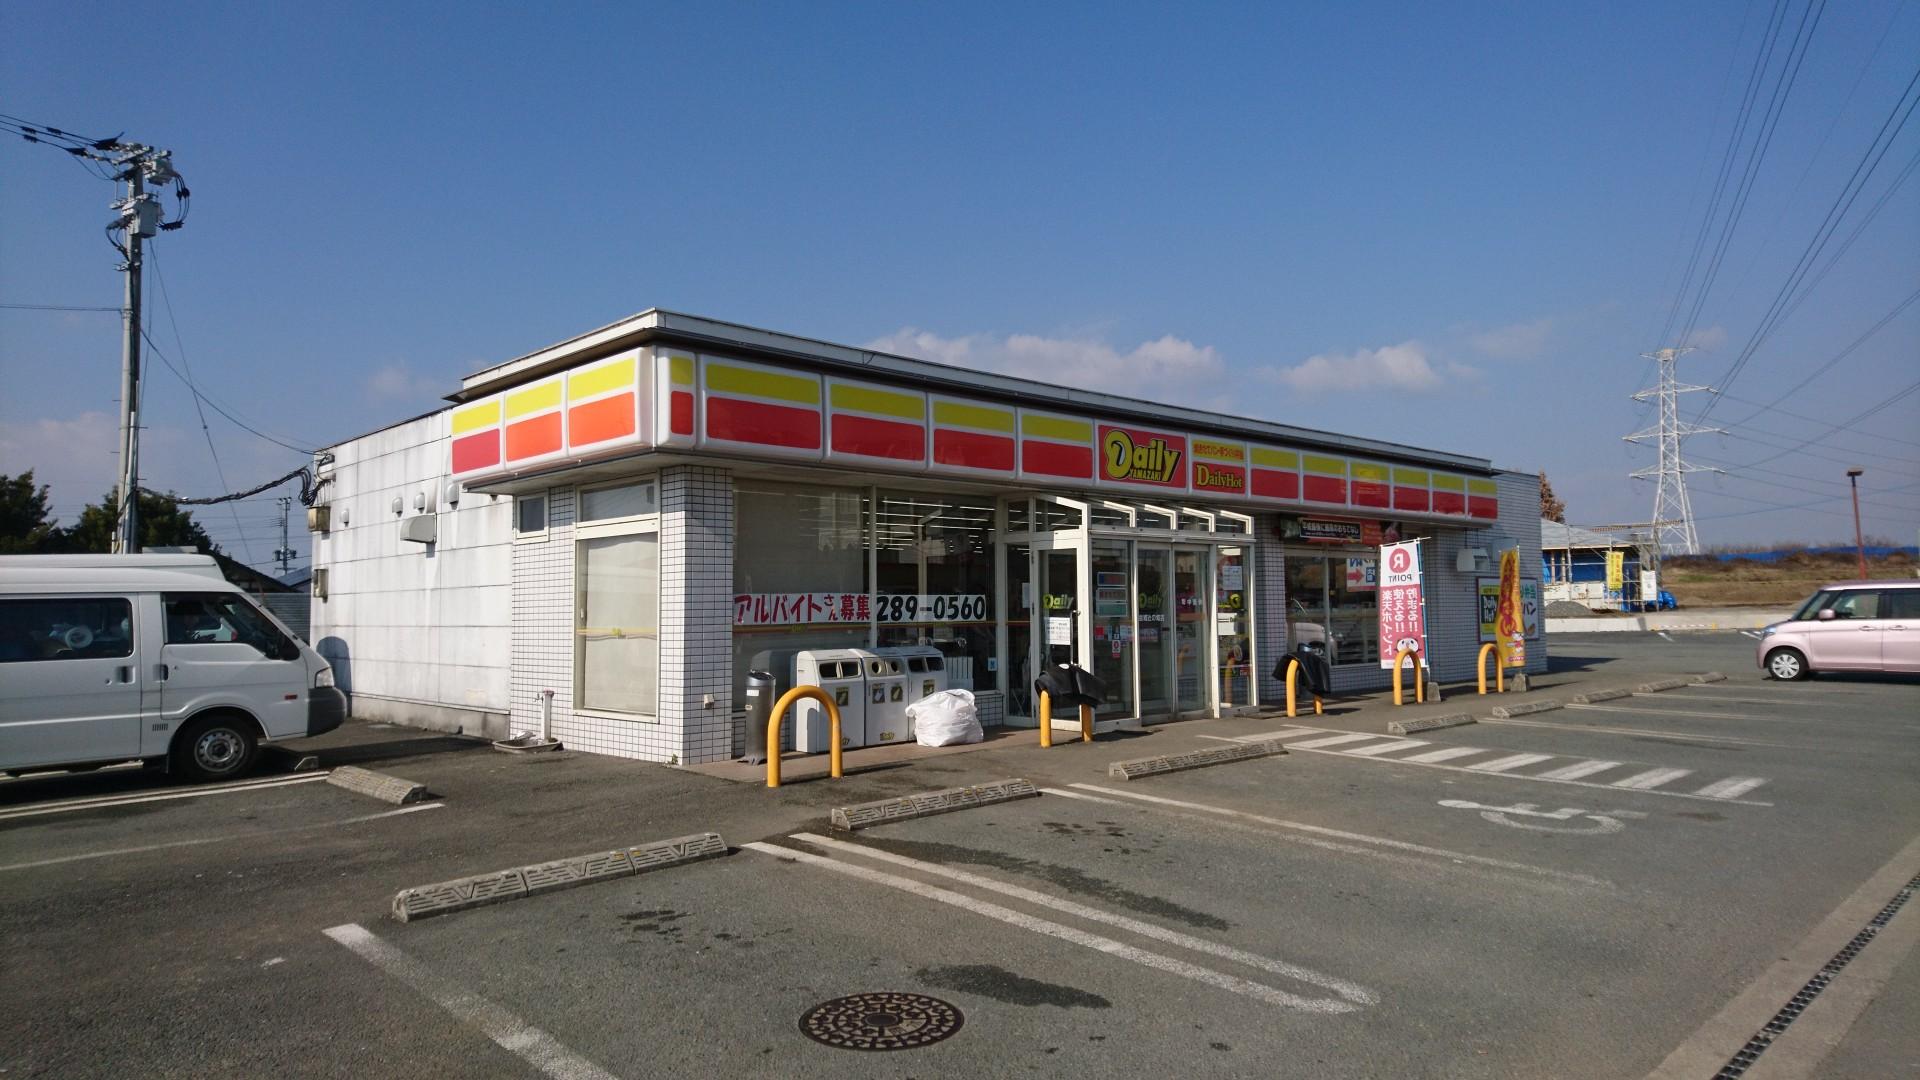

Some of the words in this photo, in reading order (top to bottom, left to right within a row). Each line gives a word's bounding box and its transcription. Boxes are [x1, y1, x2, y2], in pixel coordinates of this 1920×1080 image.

[1104, 430, 1181, 482] Daily
[1128, 468, 1161, 481] YAMAZAKI
[734, 594, 871, 624] アルバイトさん募集
[876, 595, 985, 622] 289-0560
[1043, 593, 1074, 609] Daily
